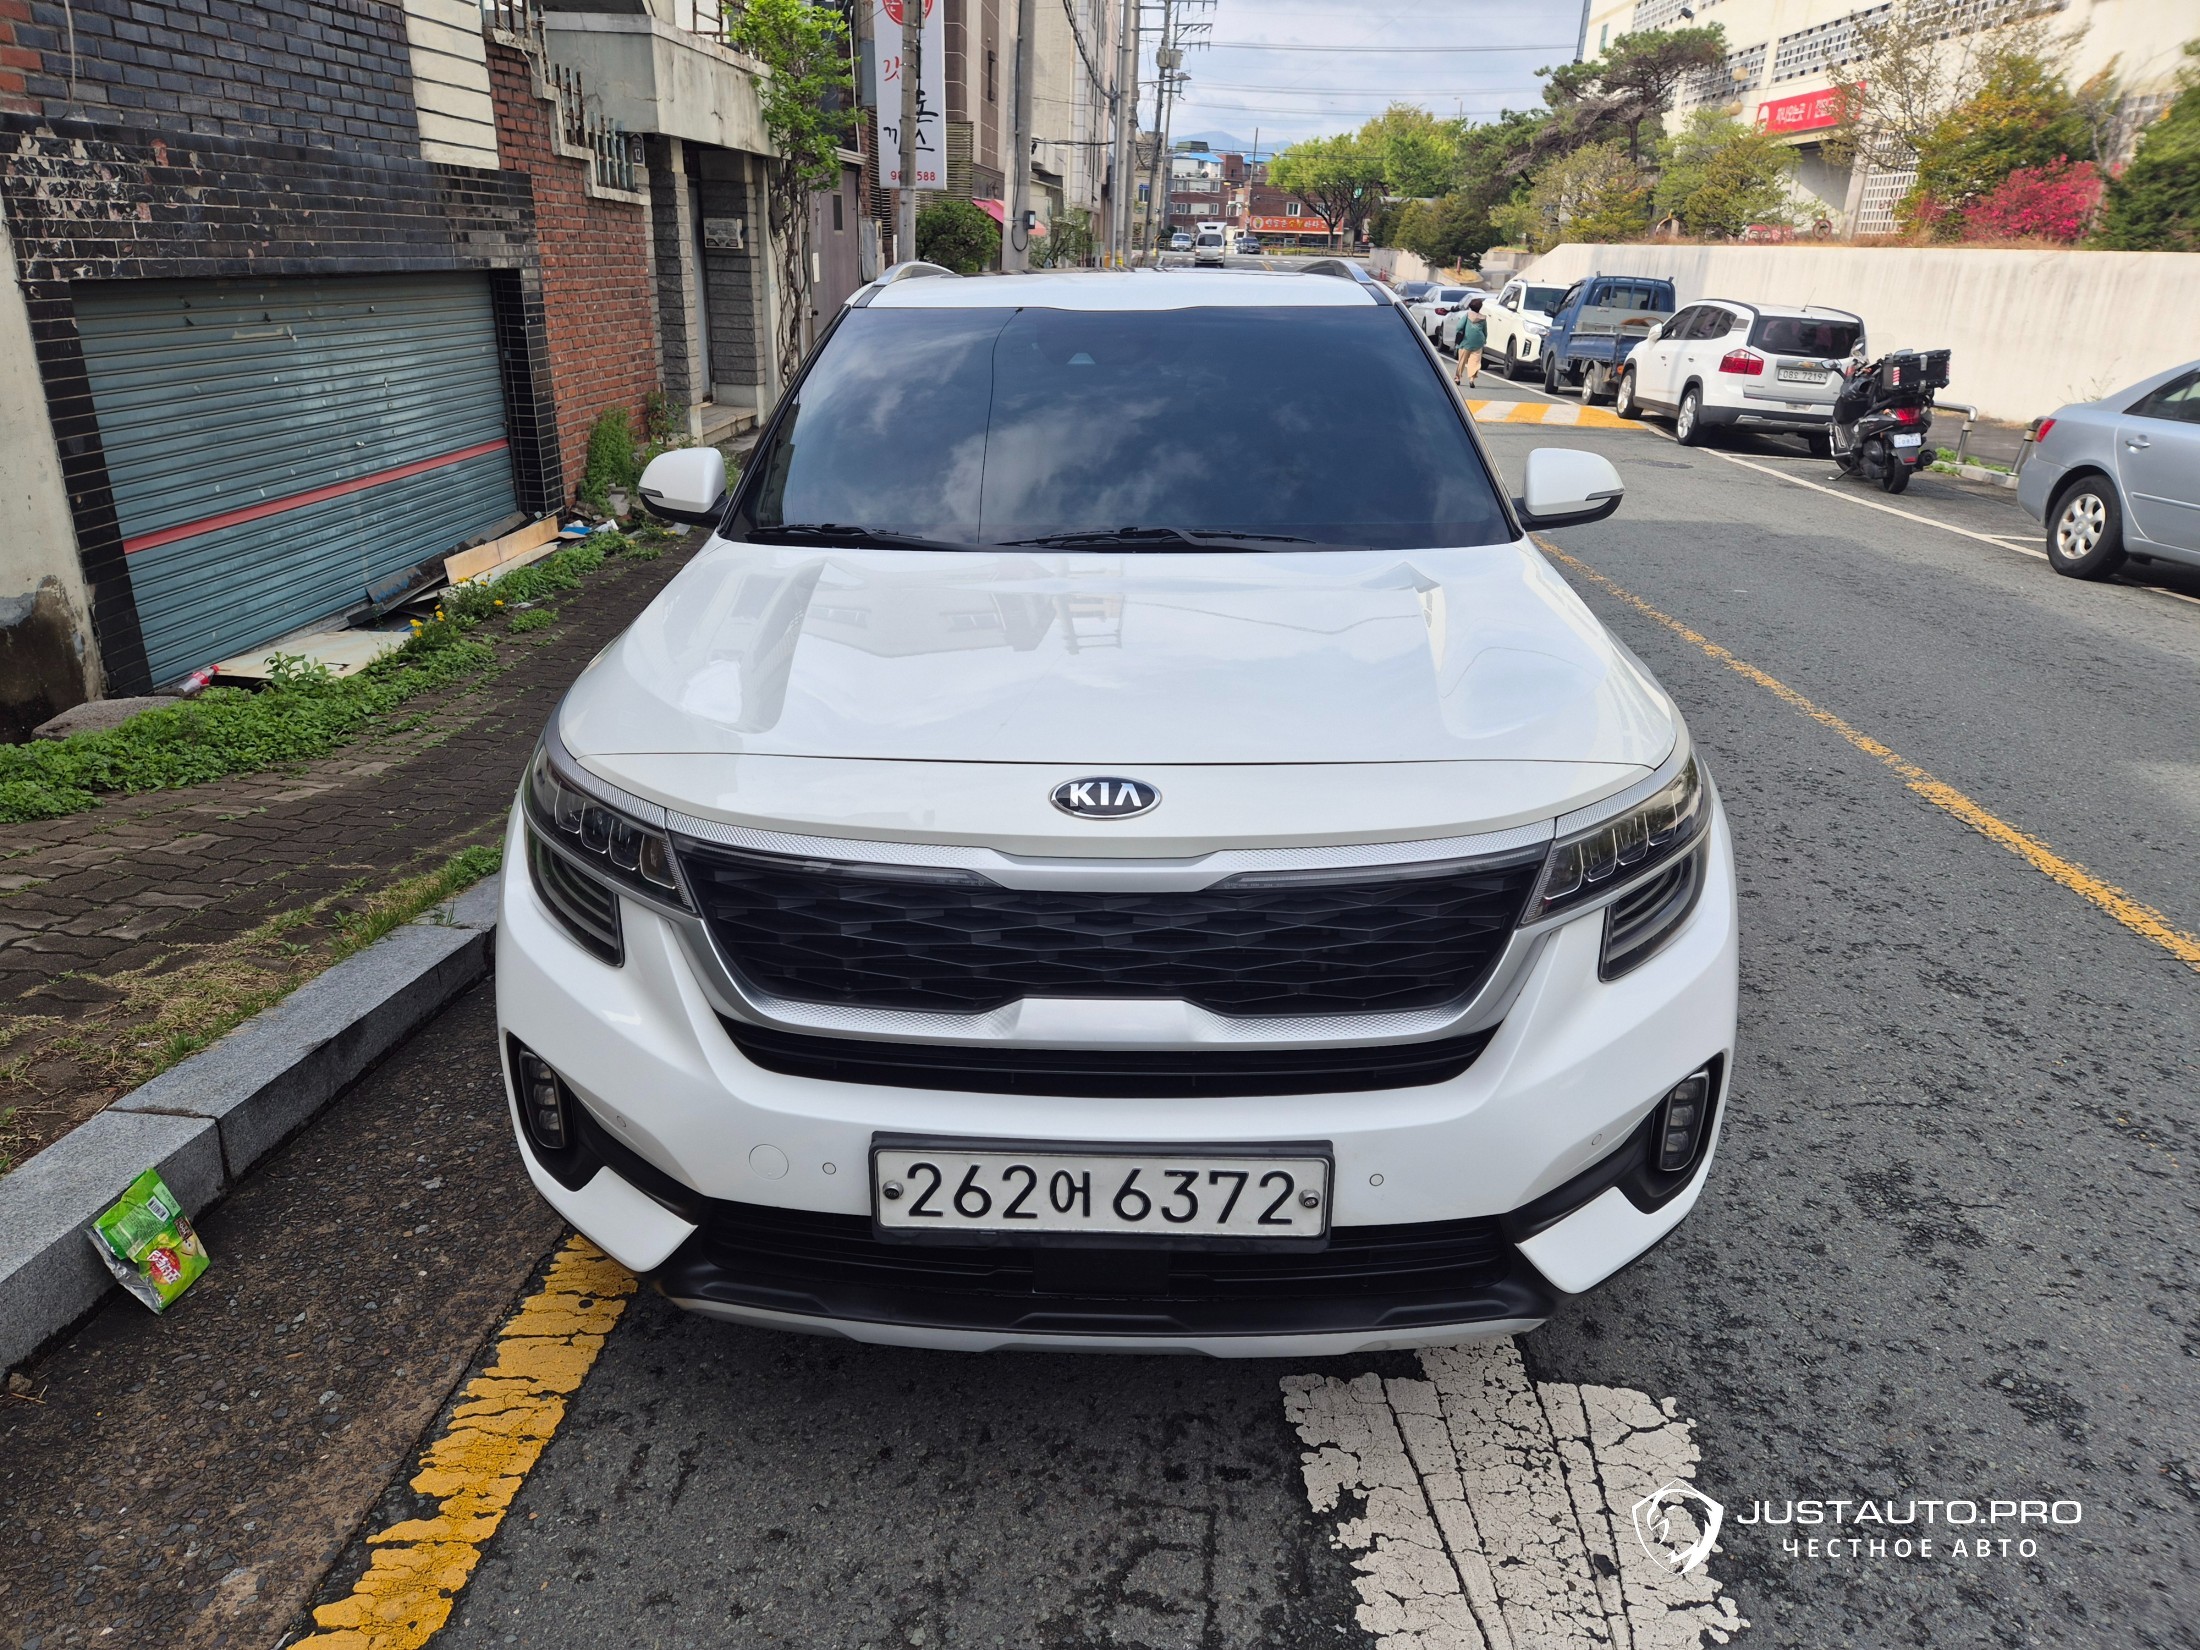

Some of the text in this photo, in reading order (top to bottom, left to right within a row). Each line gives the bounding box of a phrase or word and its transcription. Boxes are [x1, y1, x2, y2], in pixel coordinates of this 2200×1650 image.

[1802, 371, 1823, 381] 7219
[1069, 782, 1142, 807] KIA
[1112, 1168, 1295, 1225] 6372
